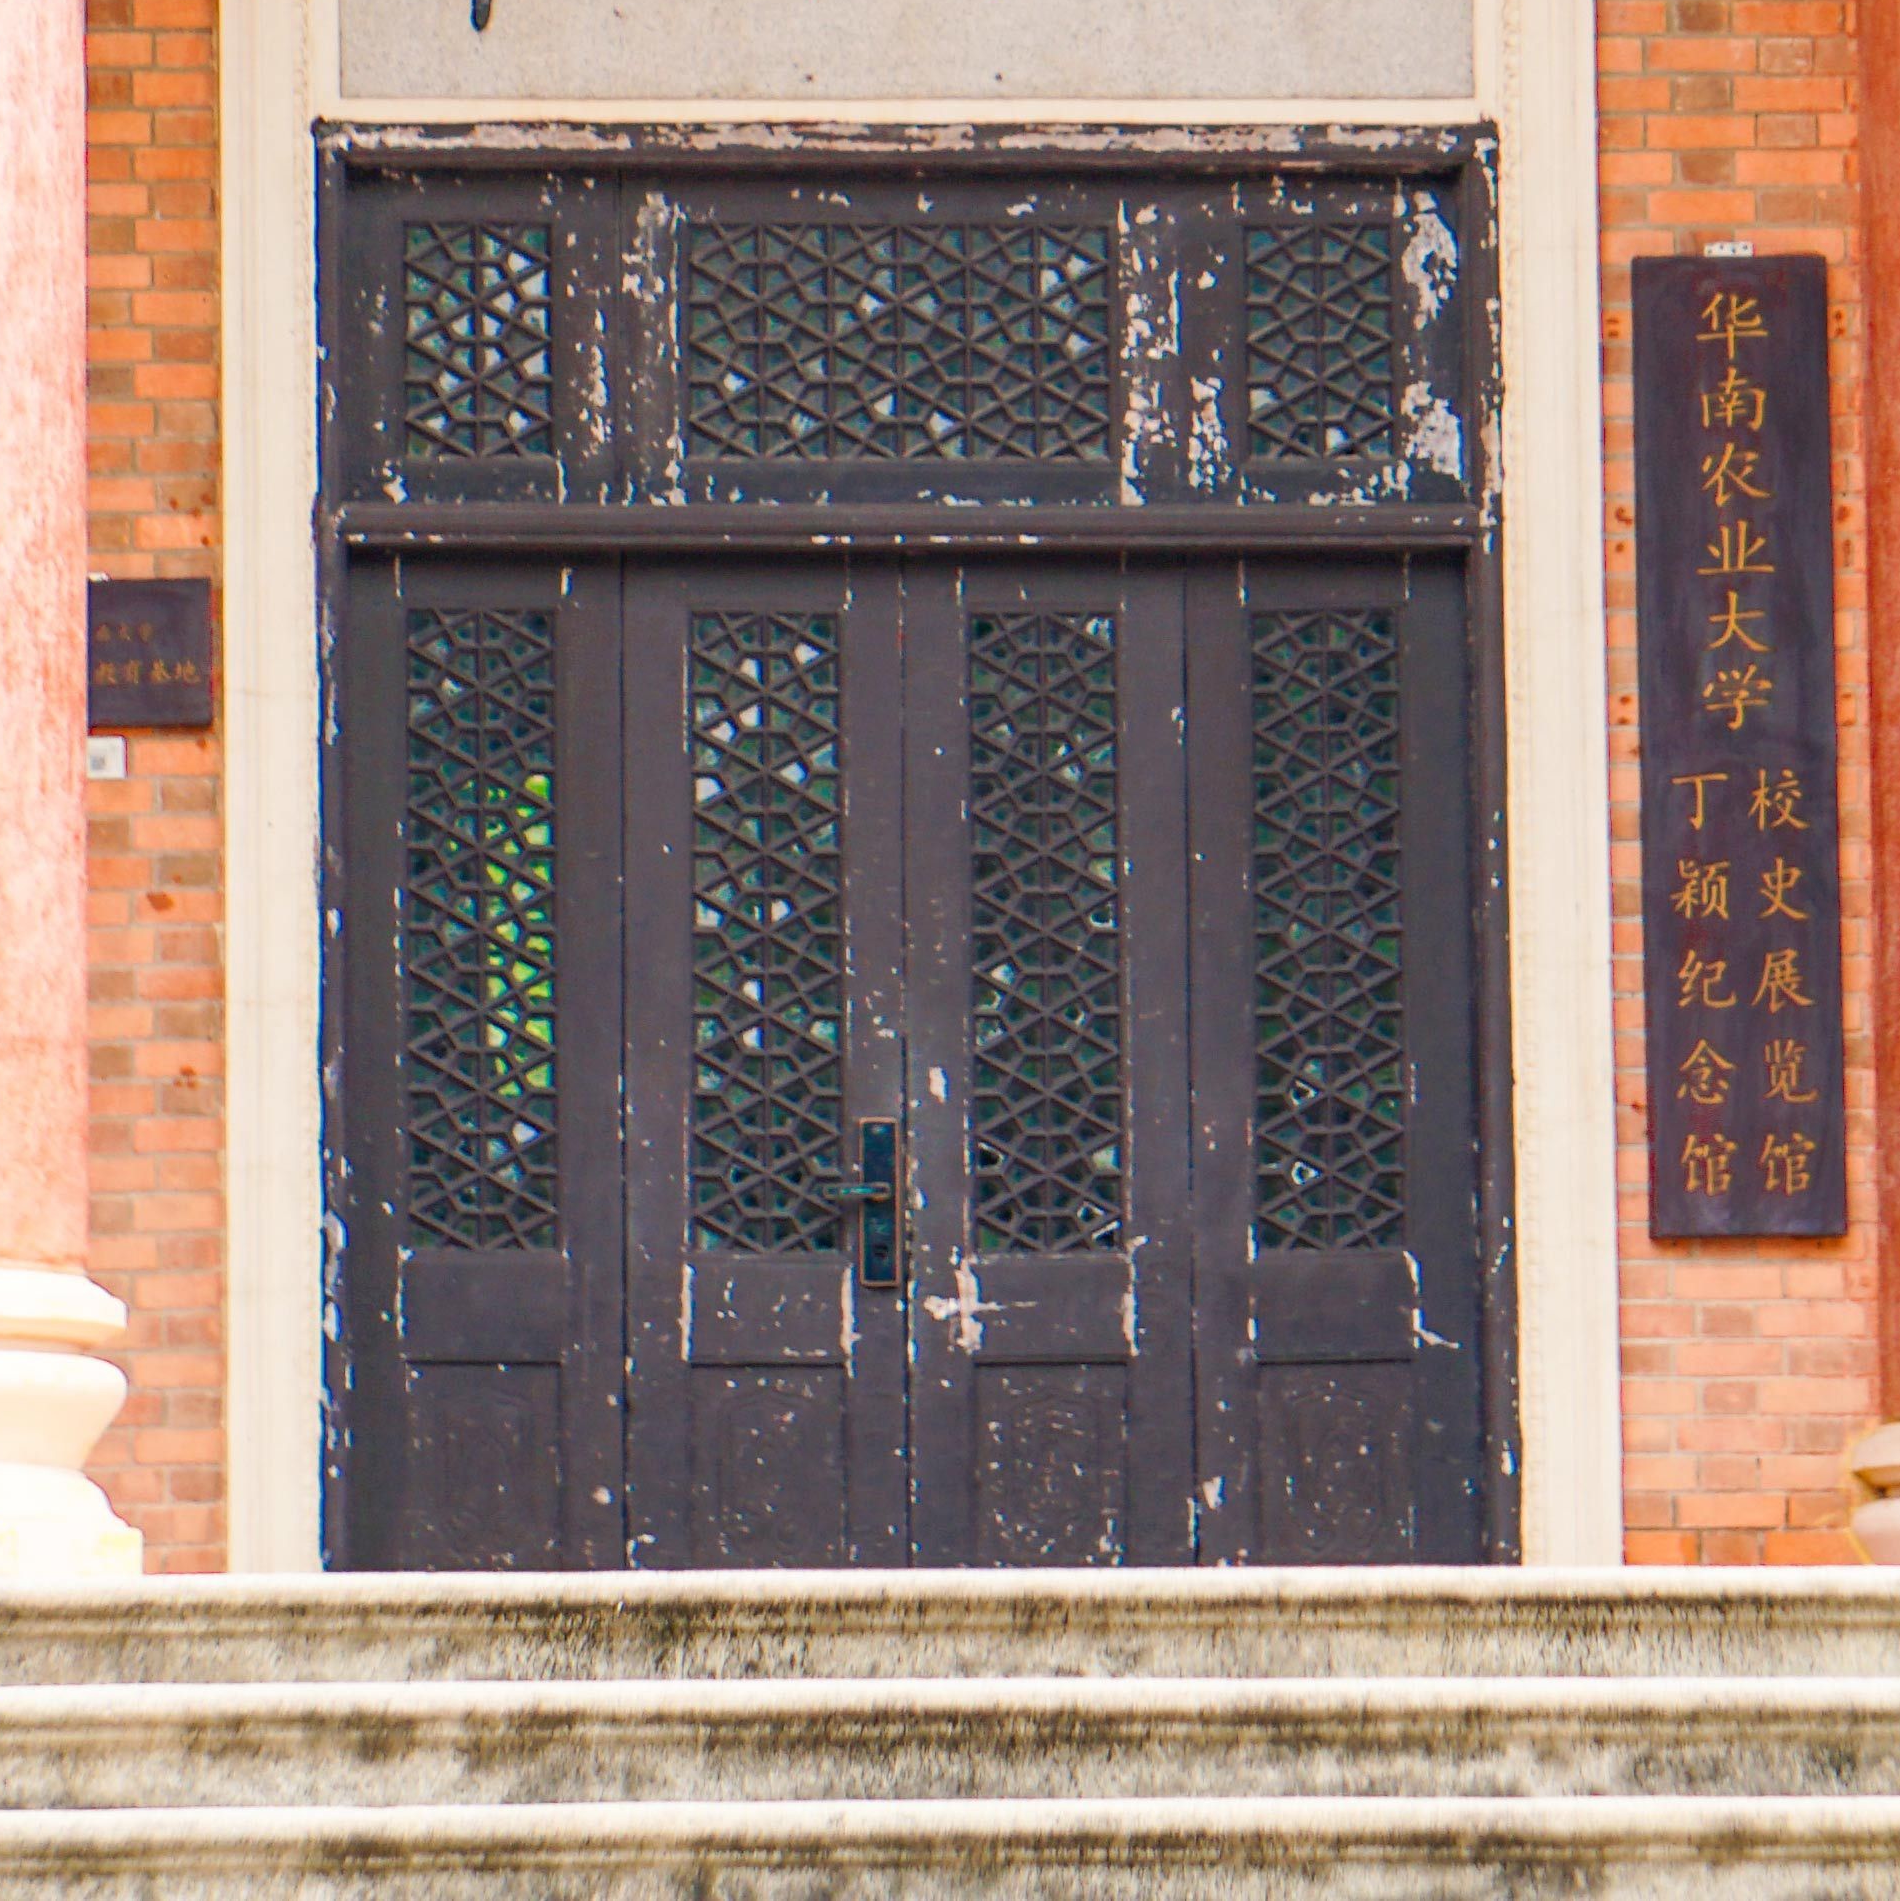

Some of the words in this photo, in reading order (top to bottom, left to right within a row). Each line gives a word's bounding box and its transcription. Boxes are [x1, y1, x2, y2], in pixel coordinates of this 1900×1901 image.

[1696, 290, 1775, 731] 华南农业大学
[1671, 771, 1737, 1196] 丁颖纪念馆
[1747, 768, 1817, 1196] 校史展览馆
